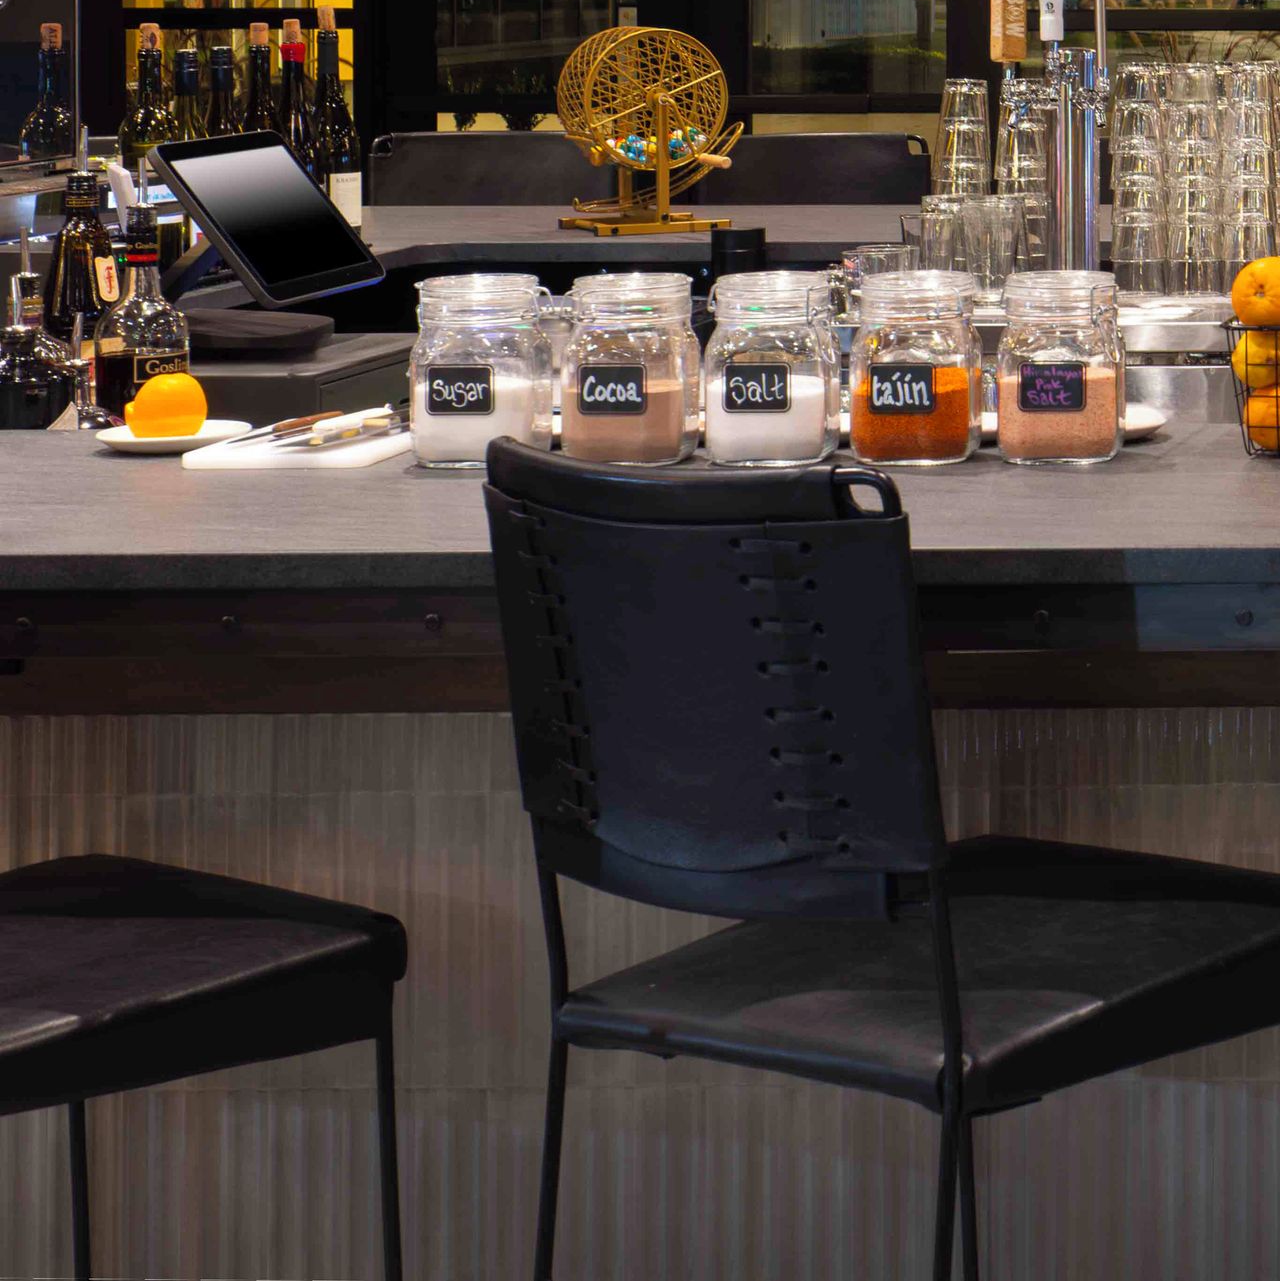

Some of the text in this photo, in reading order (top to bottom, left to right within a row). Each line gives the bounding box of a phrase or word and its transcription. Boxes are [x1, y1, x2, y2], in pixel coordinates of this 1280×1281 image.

[432, 379, 489, 408] Sugar
[583, 375, 642, 403] Cocoa
[729, 372, 784, 405] Salt
[1026, 390, 1073, 405] Salt
